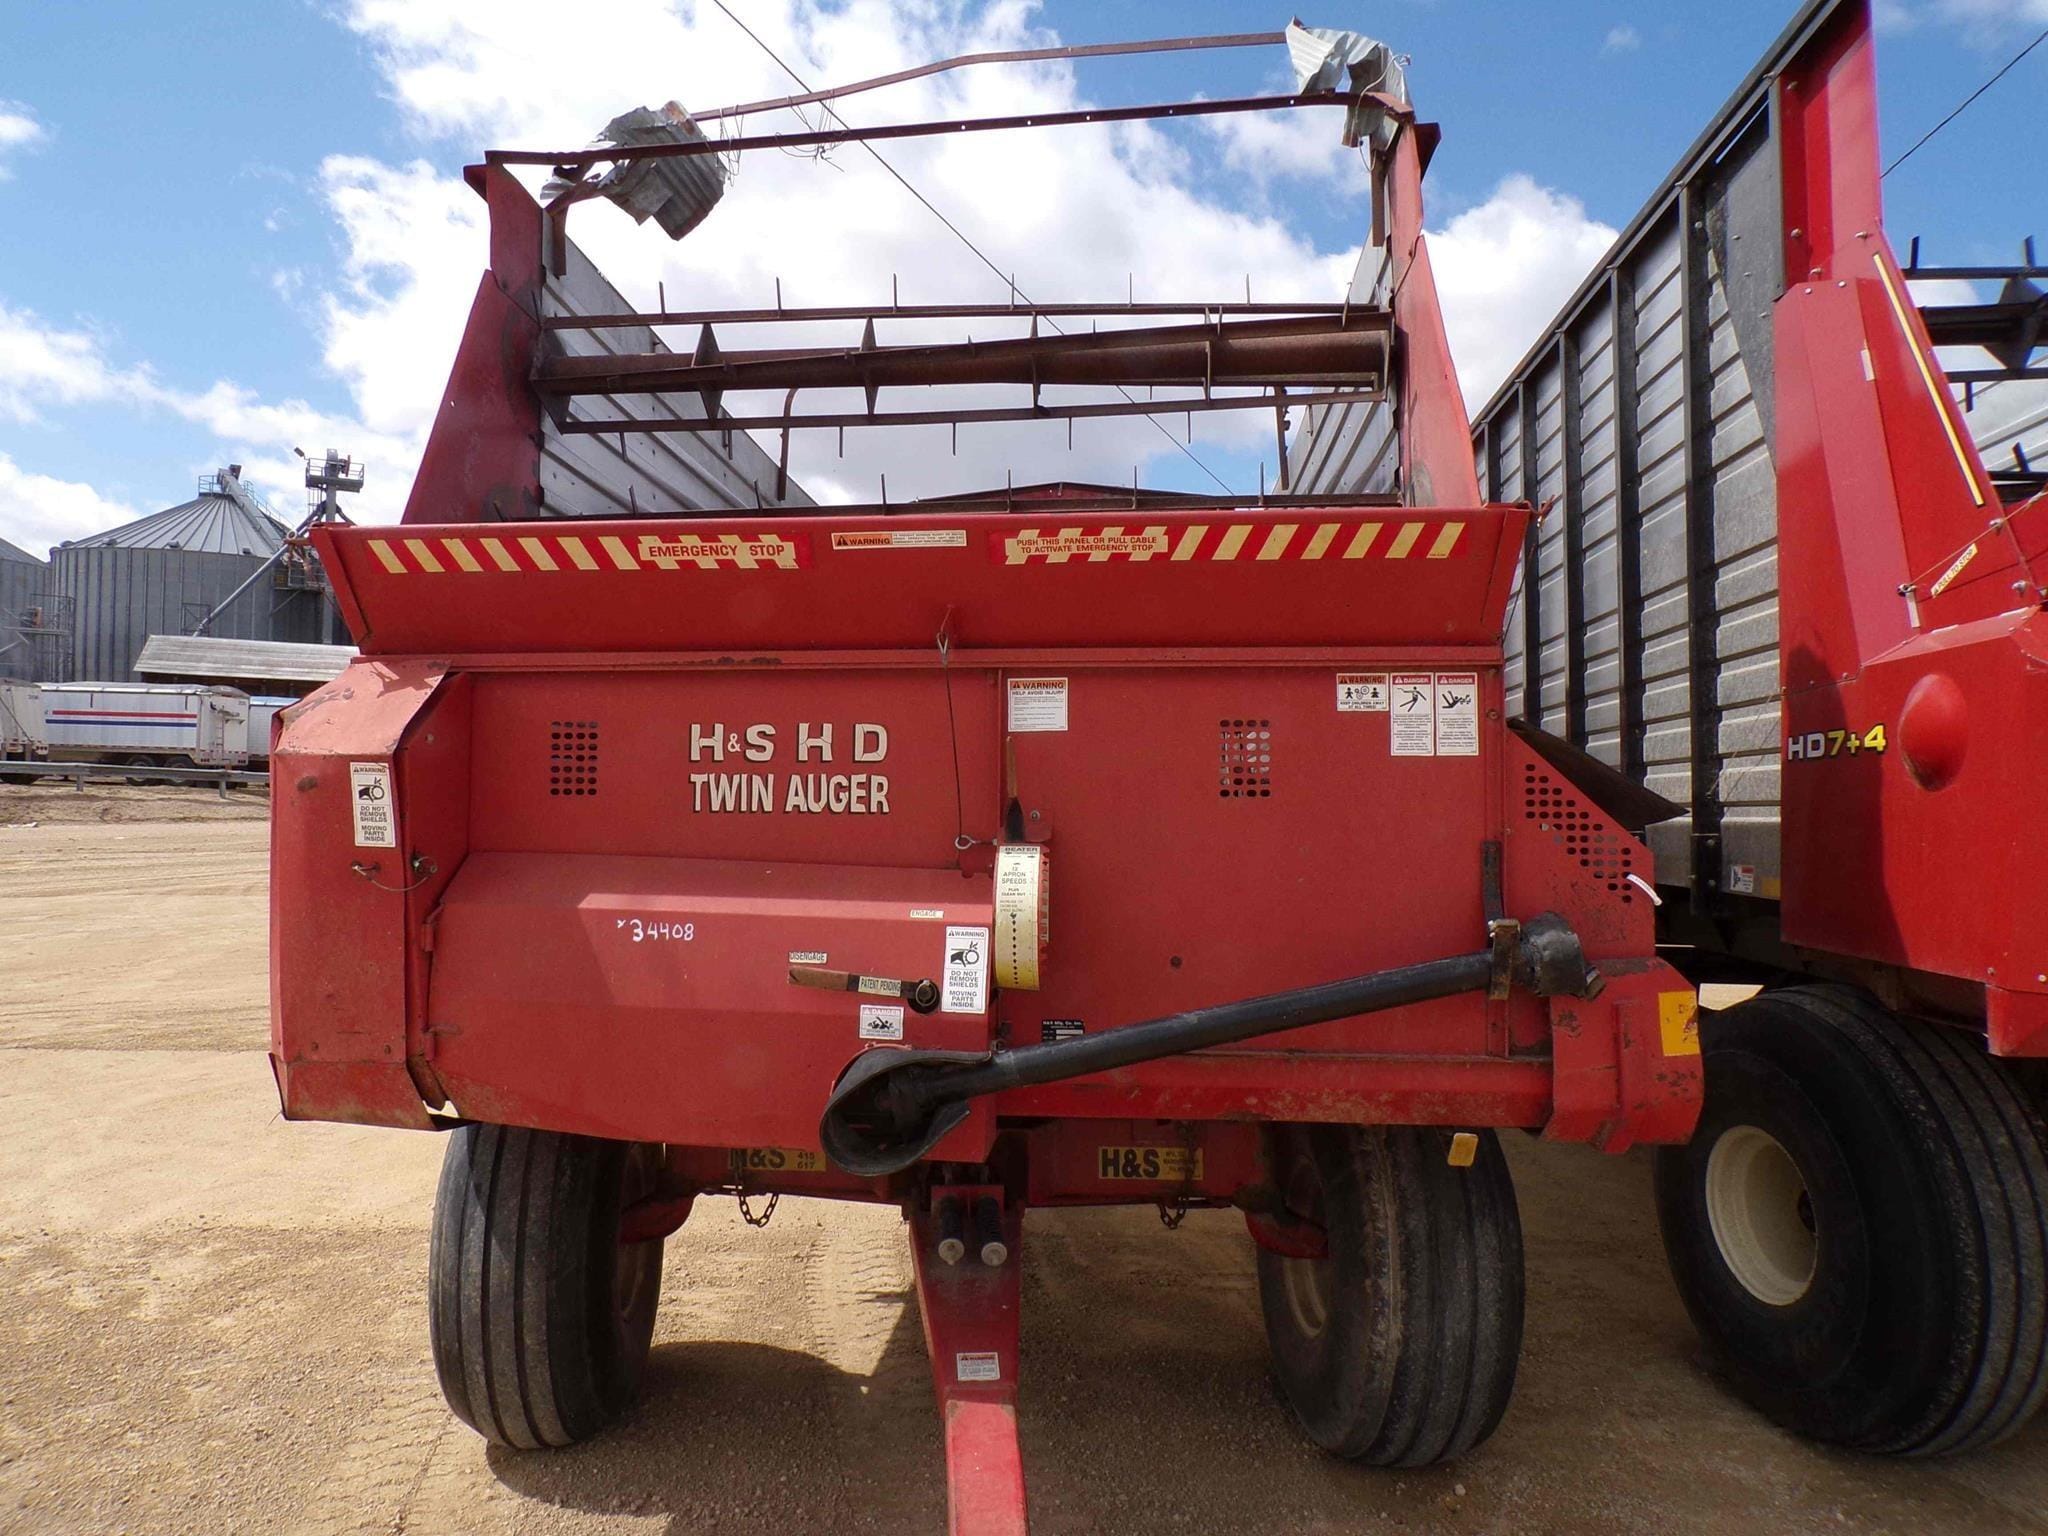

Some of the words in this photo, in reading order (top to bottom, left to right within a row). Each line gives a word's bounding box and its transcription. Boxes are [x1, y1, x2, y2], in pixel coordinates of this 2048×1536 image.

[1017, 539, 1038, 547] PUSH
[1041, 538, 1060, 546] THIS
[1064, 537, 1091, 545] PANEL
[1130, 536, 1157, 544] CABLE
[649, 545, 738, 557] EMERGENCY
[750, 545, 785, 556] STOP
[1021, 546, 1031, 554] TO
[1034, 545, 1073, 553] ACTIVATE
[1076, 544, 1129, 552] EMERGENCY
[1131, 544, 1154, 552] STOP
[1022, 681, 1064, 690] WARNING
[690, 723, 776, 761] H&S
[690, 773, 775, 812] TWIN
[784, 773, 889, 812] AUGER
[790, 952, 825, 960] DISENGAGE
[861, 978, 879, 989] PATENT
[880, 980, 901, 991] PENDING
[1101, 1149, 1160, 1178] H&S
